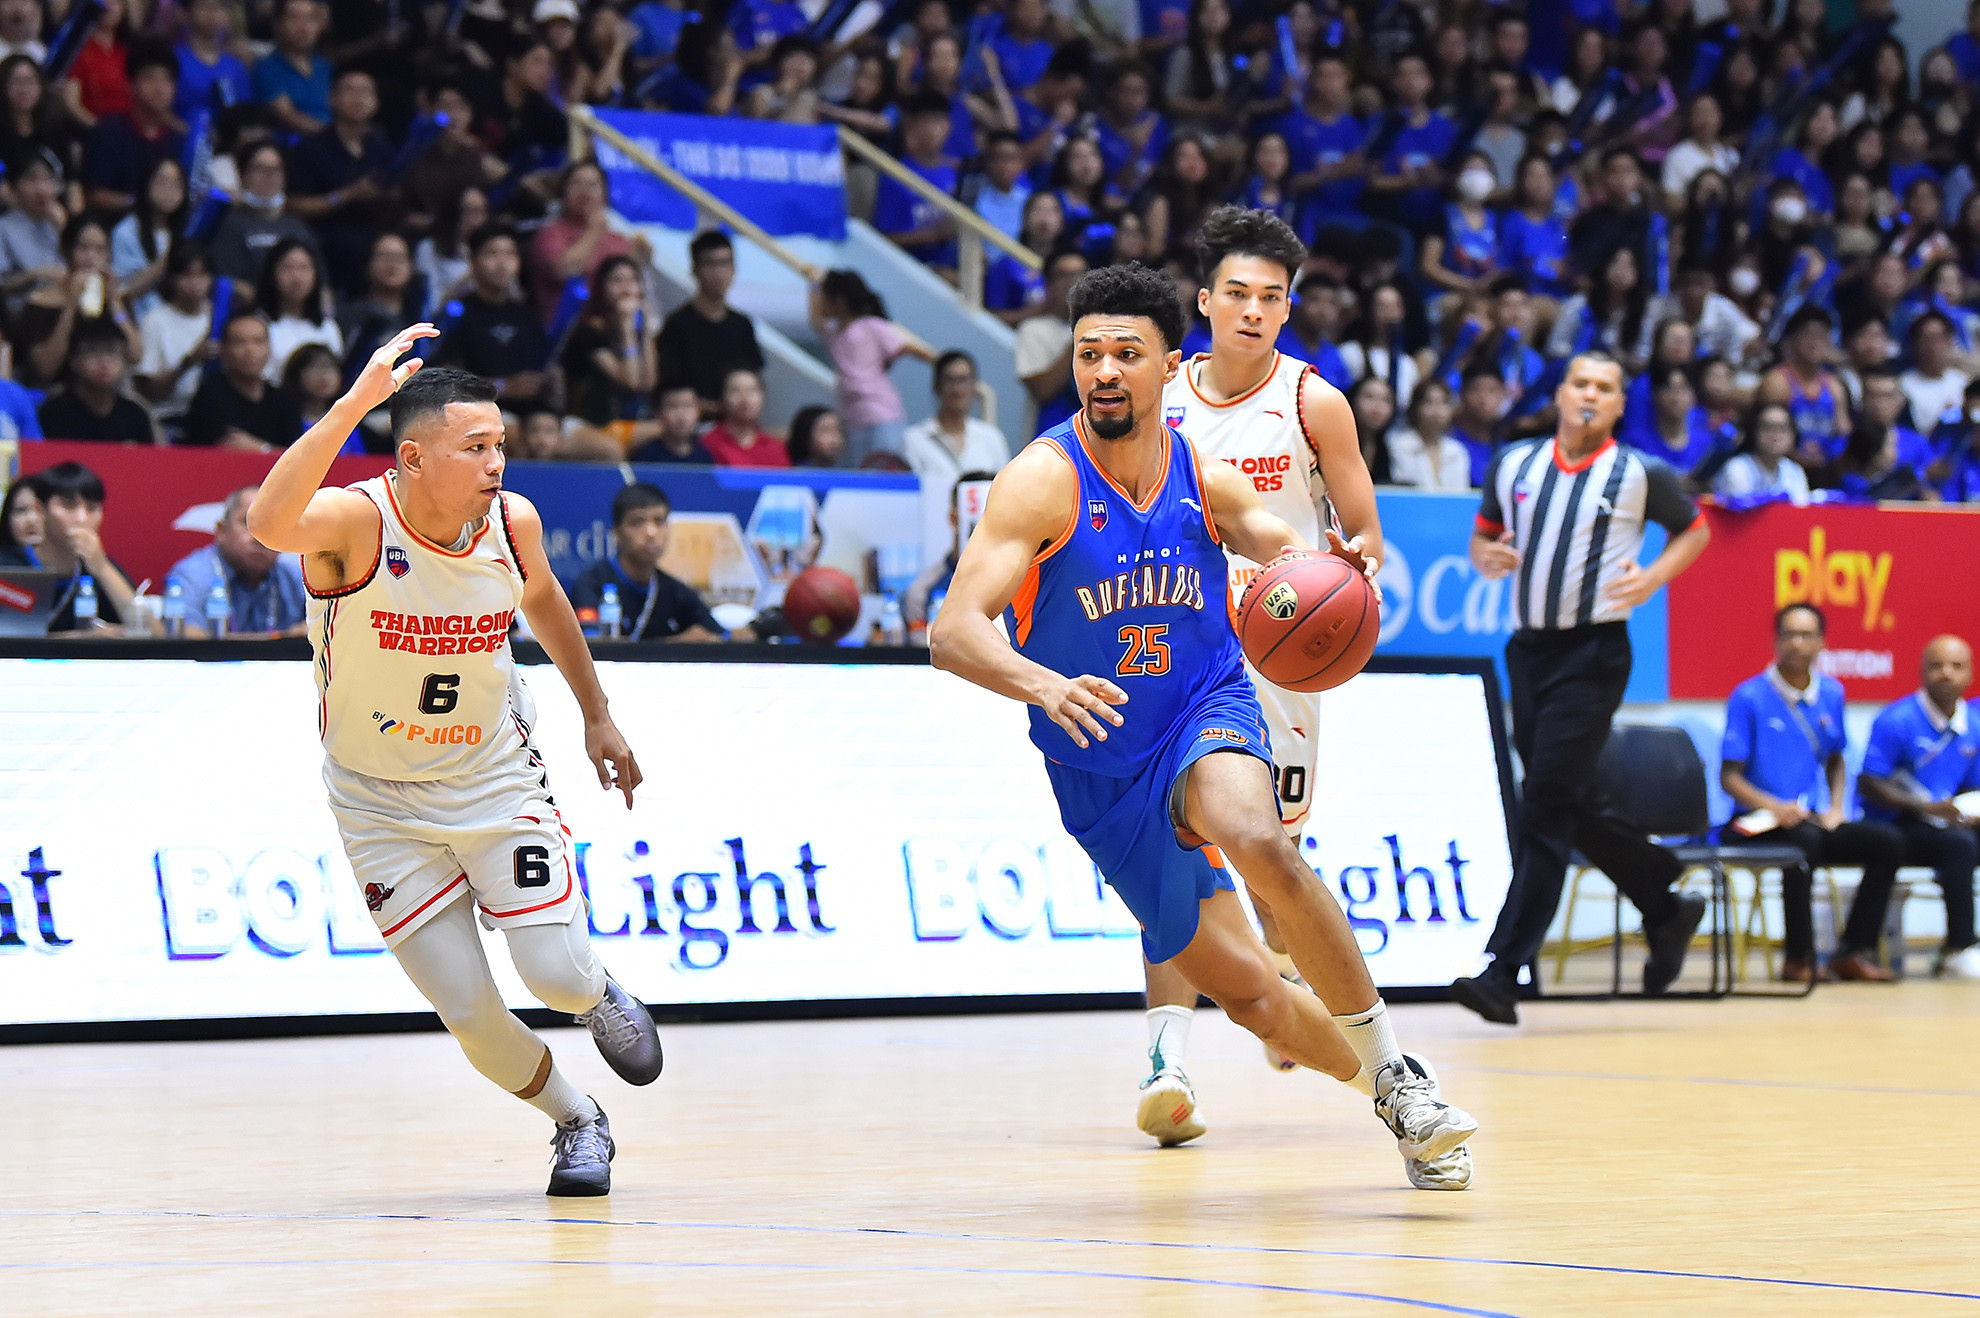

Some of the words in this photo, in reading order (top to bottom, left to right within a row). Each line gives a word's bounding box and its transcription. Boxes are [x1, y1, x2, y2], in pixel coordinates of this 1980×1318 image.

[1075, 564, 1205, 621] BUFFALOES
[1265, 587, 1289, 608] VBA
[1115, 623, 1171, 677] 25
[418, 672, 461, 715] 6
[372, 711, 386, 722] By
[406, 723, 482, 746] PJICO
[514, 845, 551, 889] 6
[575, 836, 836, 969] Light
